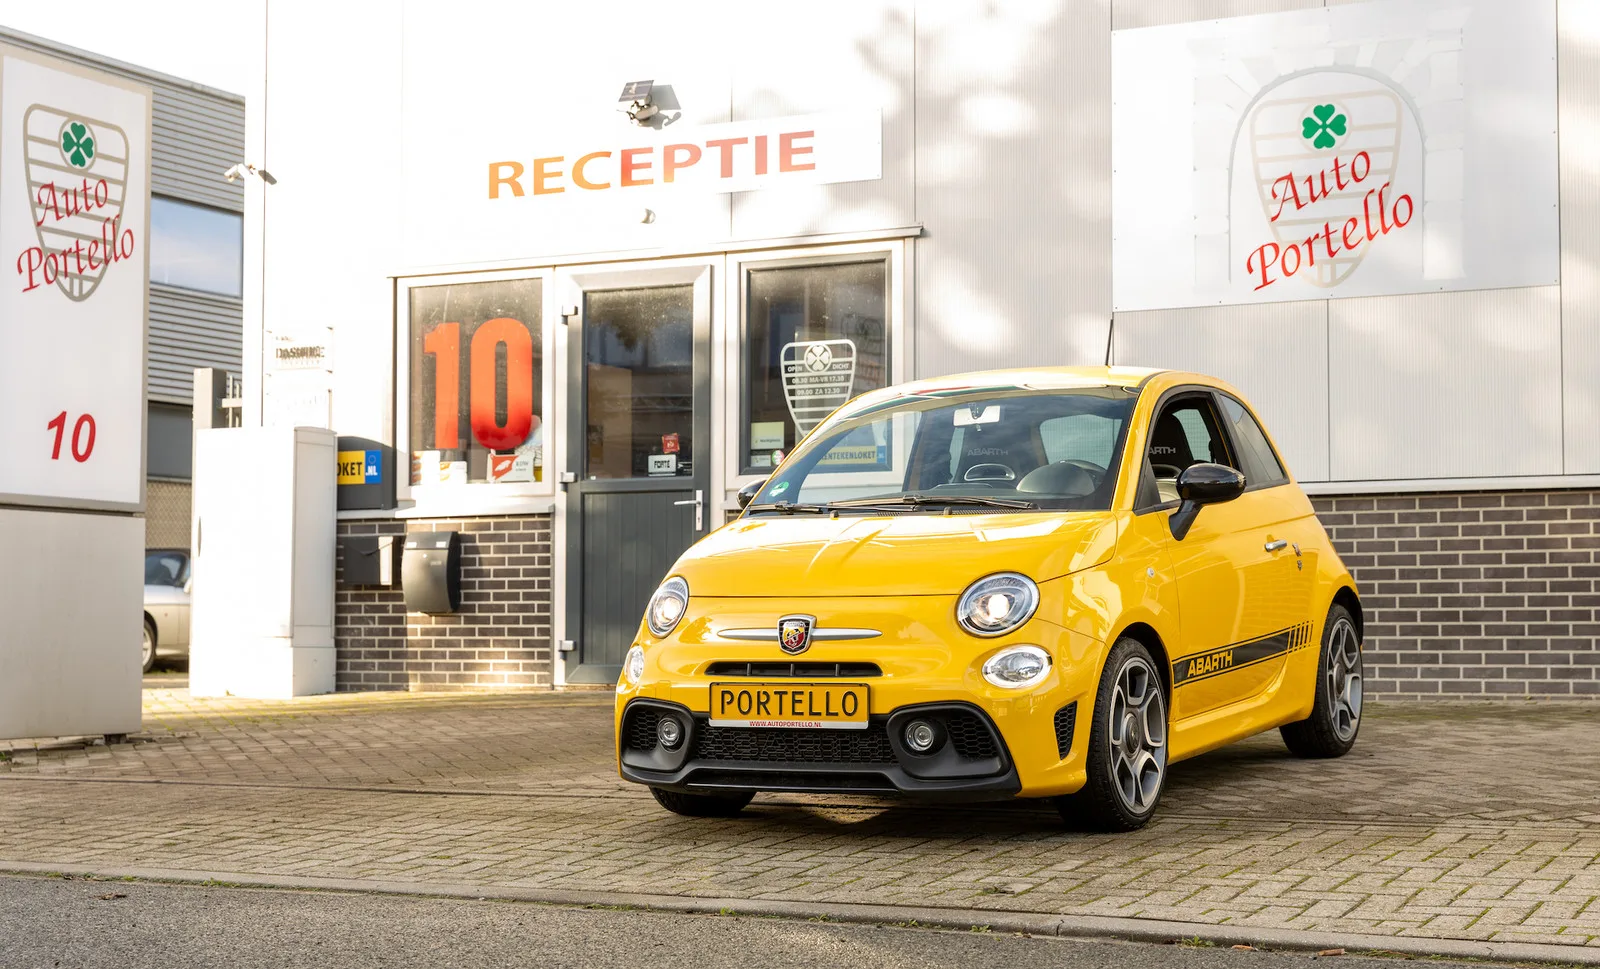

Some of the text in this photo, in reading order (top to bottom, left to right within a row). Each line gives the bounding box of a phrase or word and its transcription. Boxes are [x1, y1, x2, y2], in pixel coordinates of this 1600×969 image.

[488, 130, 816, 199] RECEPTIE
[1270, 150, 1371, 222] Auto
[36, 178, 108, 227] Auto
[17, 214, 135, 293] Portello
[1246, 181, 1414, 291] Portello
[424, 317, 533, 451] 10
[787, 365, 803, 373] OPEN
[47, 411, 96, 463] 10
[822, 451, 876, 461] ENTEKENLOKET
[967, 447, 1009, 457] ABARTH
[1187, 650, 1233, 678] ABARTH
[720, 689, 858, 717] PORTELLO
[749, 720, 823, 728] WWW.AUTOPORTELLO.NL
